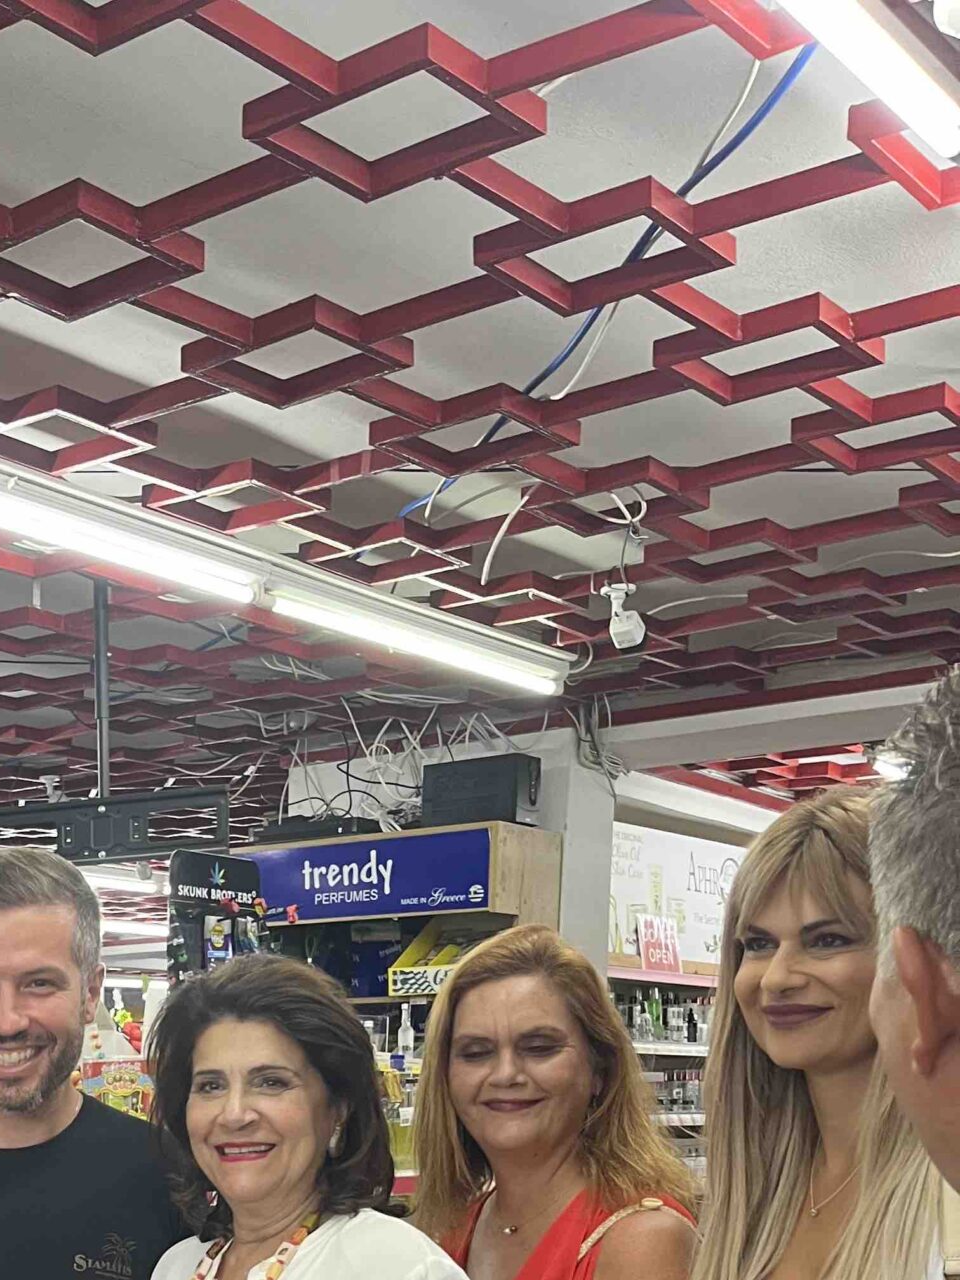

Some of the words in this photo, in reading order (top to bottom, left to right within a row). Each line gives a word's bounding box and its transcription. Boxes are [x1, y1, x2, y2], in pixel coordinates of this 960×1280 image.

[302, 849, 393, 895] trendy
[178, 884, 208, 900] SKUNK
[314, 888, 379, 906] PERFUMES
[400, 897, 419, 905] MADE
[428, 887, 466, 907] Greece
[649, 948, 674, 966] OPEN
